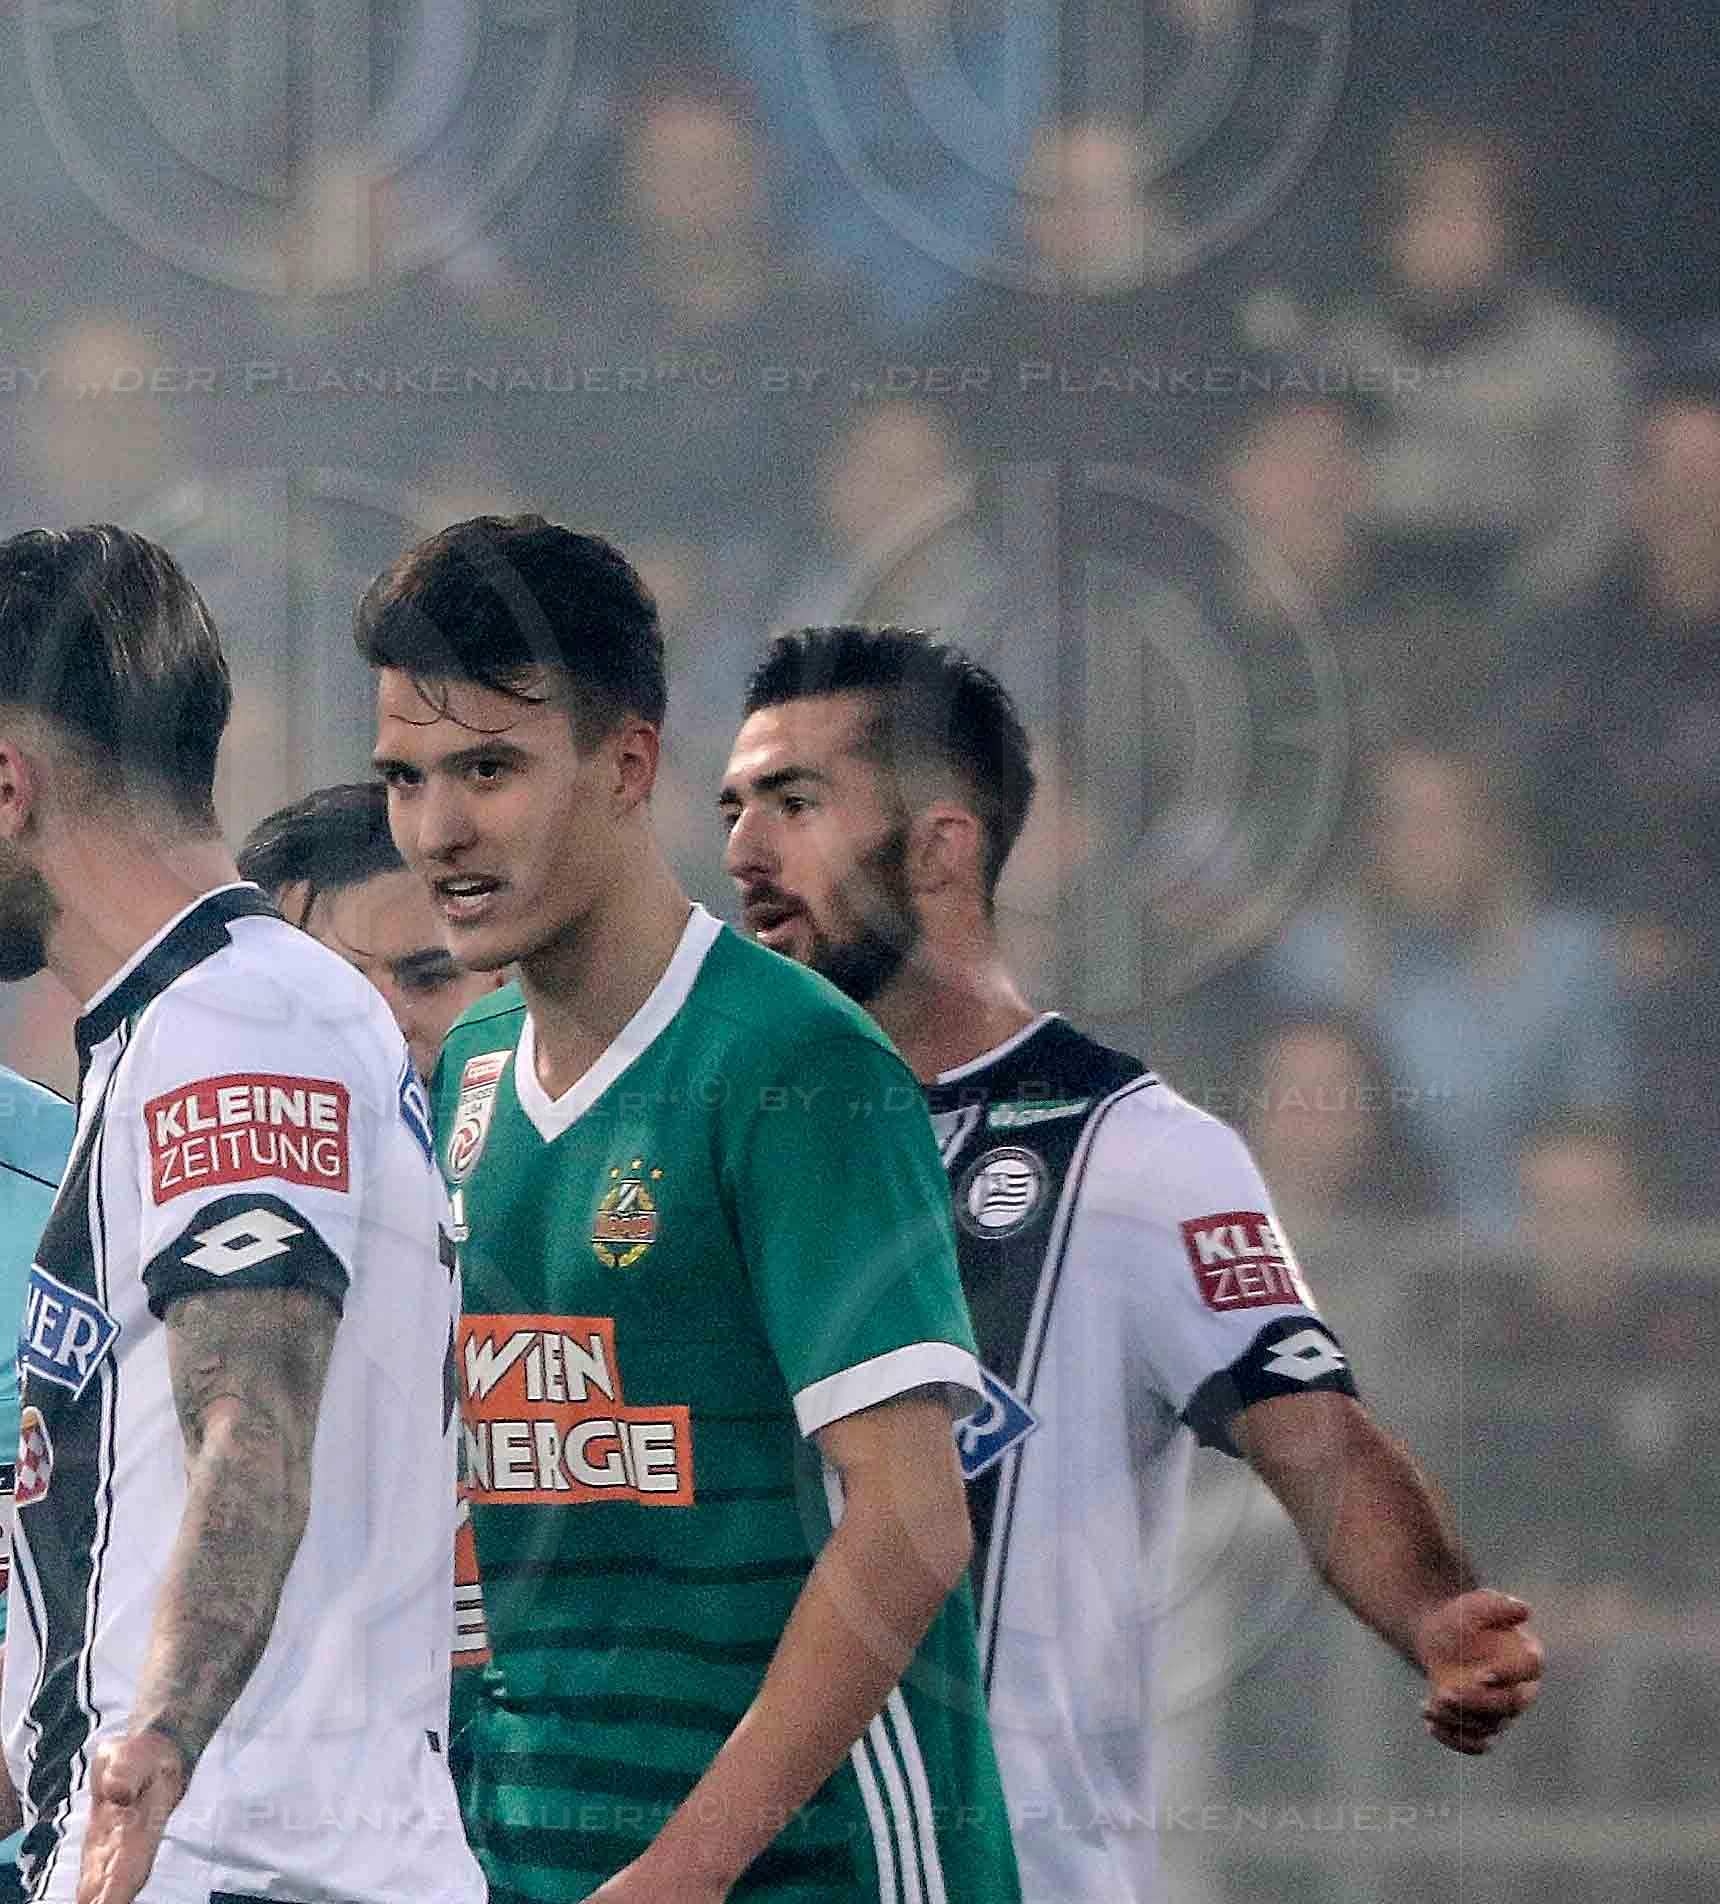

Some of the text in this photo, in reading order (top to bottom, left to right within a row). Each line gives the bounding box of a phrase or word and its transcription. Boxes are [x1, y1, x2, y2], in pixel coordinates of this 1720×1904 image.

[155, 1086, 339, 1147] KLEINE
[160, 1129, 342, 1190] ZEITUNG
[464, 1332, 615, 1402] WIEN
[461, 1419, 679, 1493] NERGIE
